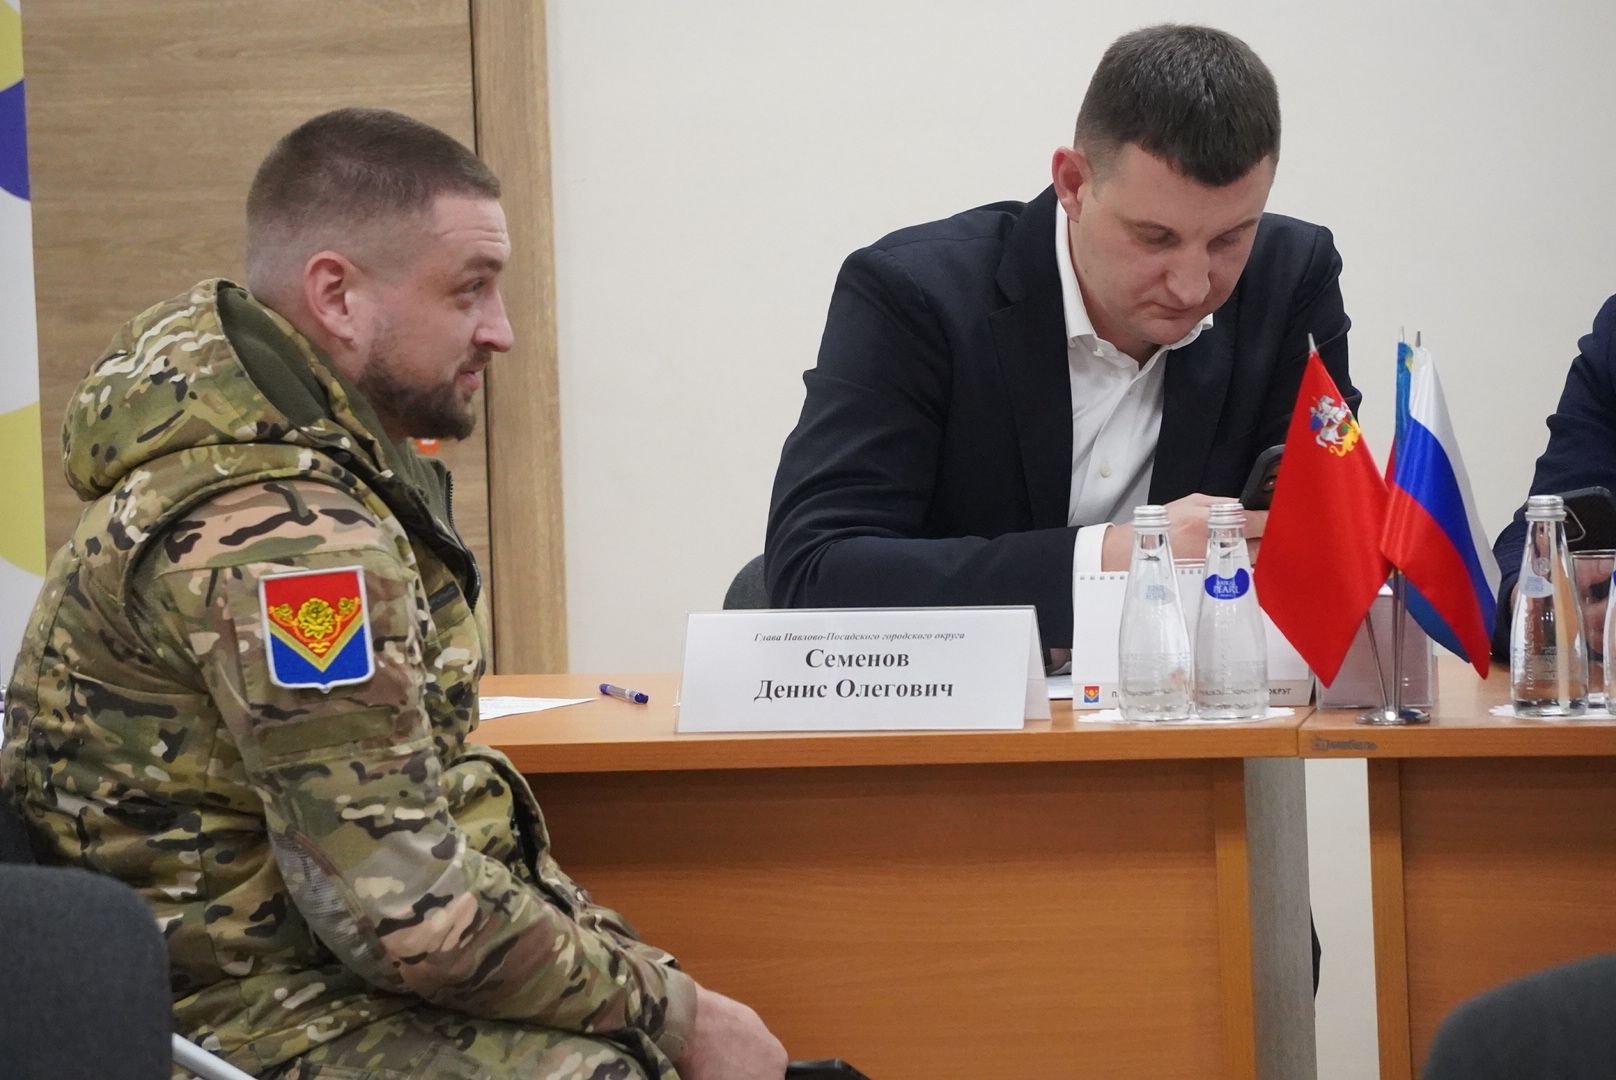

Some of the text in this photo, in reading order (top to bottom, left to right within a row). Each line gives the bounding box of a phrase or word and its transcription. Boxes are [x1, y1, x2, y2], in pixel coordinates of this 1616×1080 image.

[754, 631, 966, 643] Глава Павлово-Посадского городского округа
[805, 648, 910, 668] Семенов
[753, 678, 954, 702] Денис Олегович
